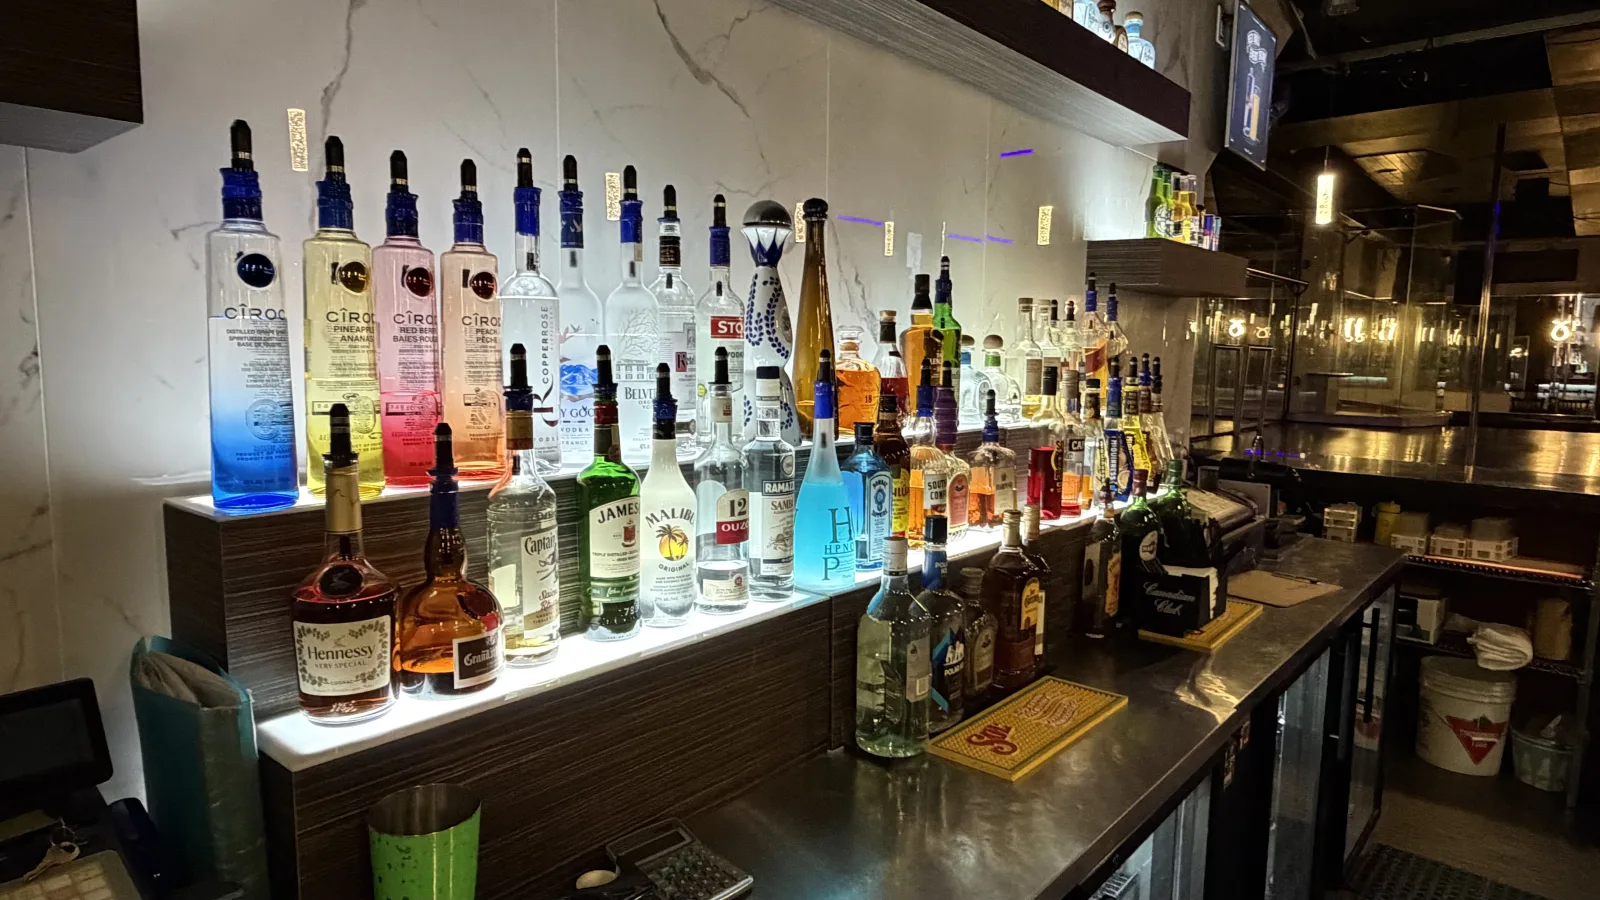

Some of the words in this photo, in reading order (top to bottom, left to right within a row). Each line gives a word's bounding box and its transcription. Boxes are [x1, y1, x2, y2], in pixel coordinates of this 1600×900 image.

[393, 310, 437, 325] CÎRO
[718, 320, 743, 334] STO
[624, 386, 656, 400] BELVE
[570, 406, 595, 418] GOO
[765, 482, 793, 493] RAMAZ
[927, 479, 947, 490] SOUT
[598, 502, 640, 524] JAMES
[729, 497, 747, 517] 12
[645, 507, 695, 528] MALIBU
[659, 562, 689, 573] ORIGINAL
[307, 644, 376, 661] Hennessy
[334, 660, 368, 669] SPECIAL
